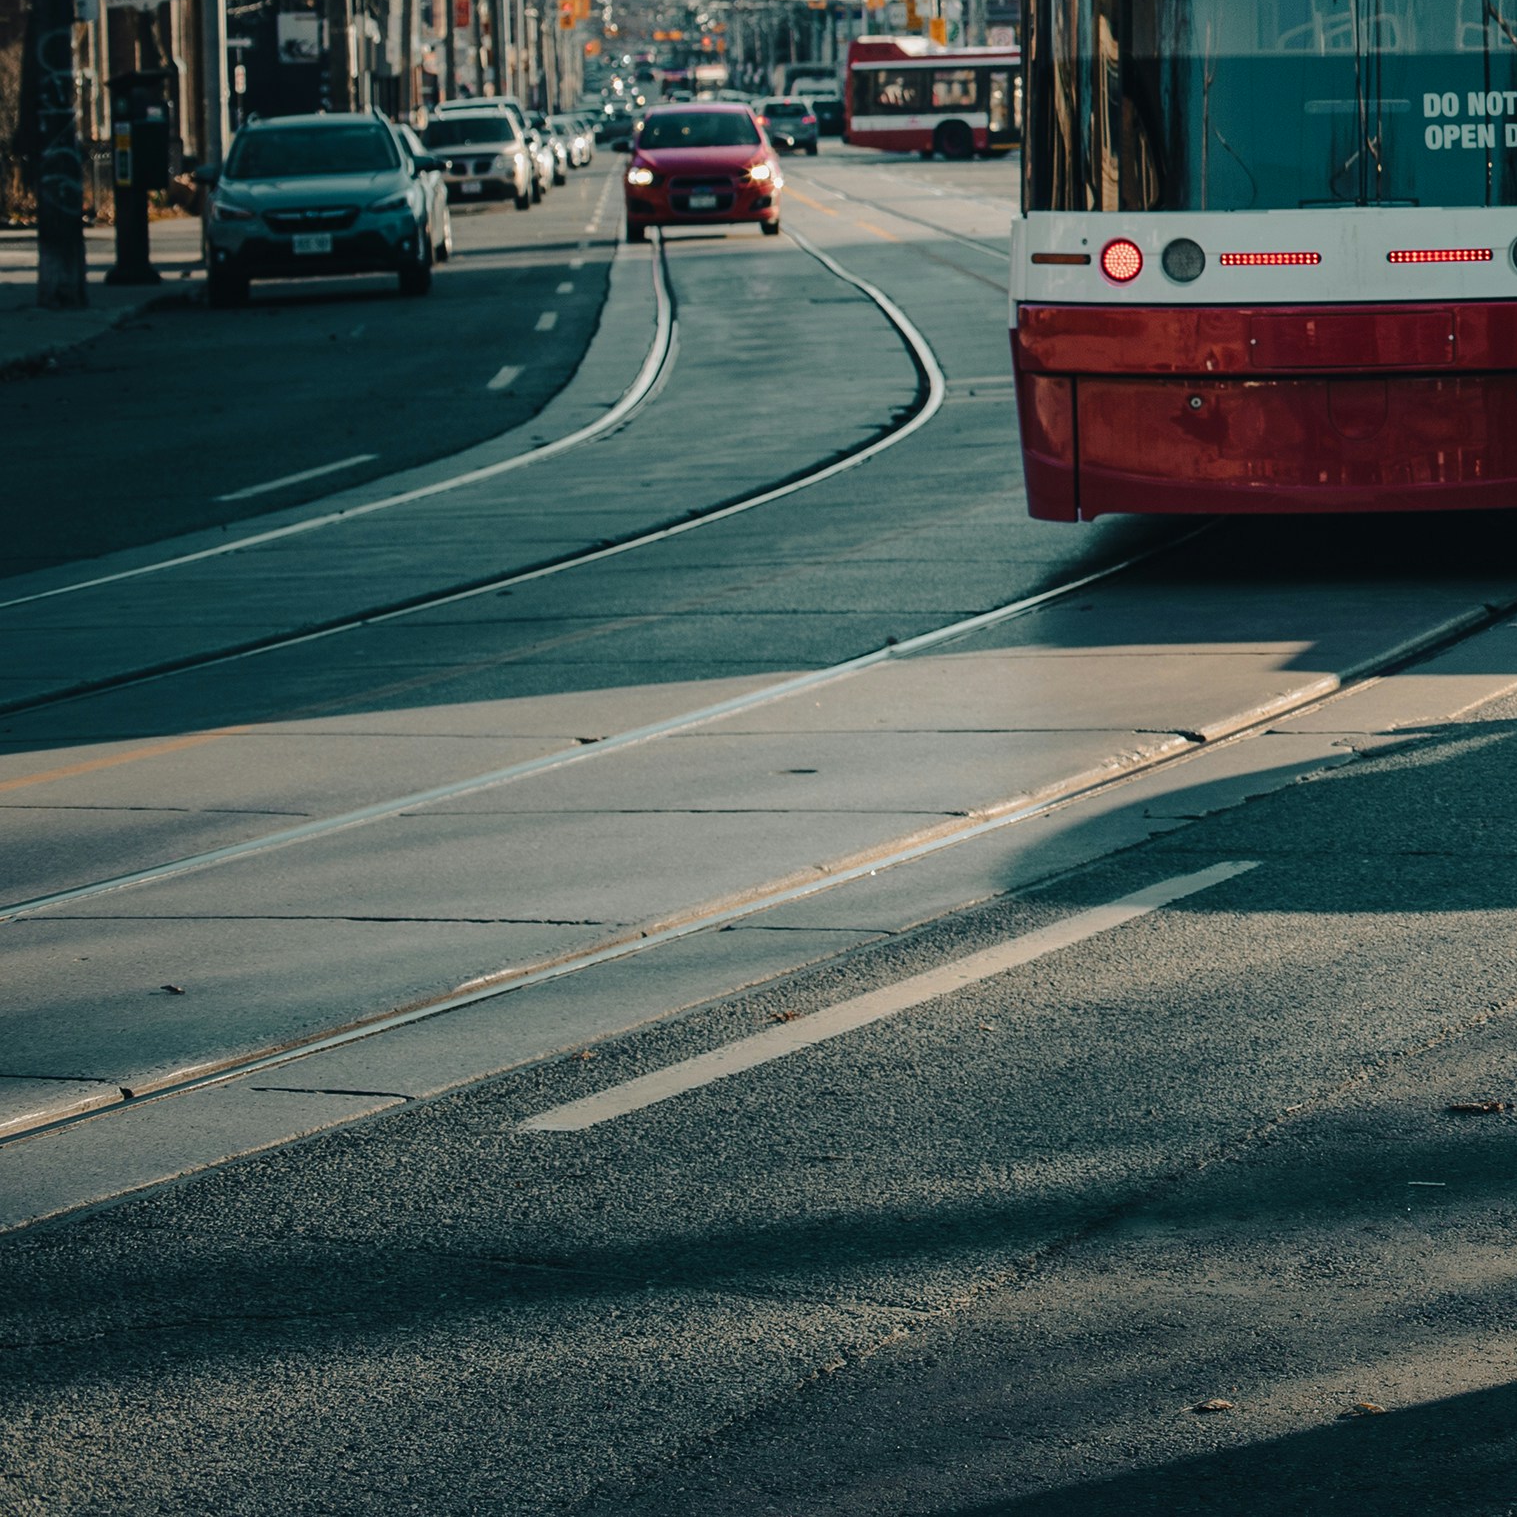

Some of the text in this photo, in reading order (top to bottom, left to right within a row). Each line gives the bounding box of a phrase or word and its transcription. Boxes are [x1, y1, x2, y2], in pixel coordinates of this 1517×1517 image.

[1423, 93, 1459, 117] DO
[1467, 91, 1517, 116] NOT
[1424, 123, 1496, 150] OPEN
